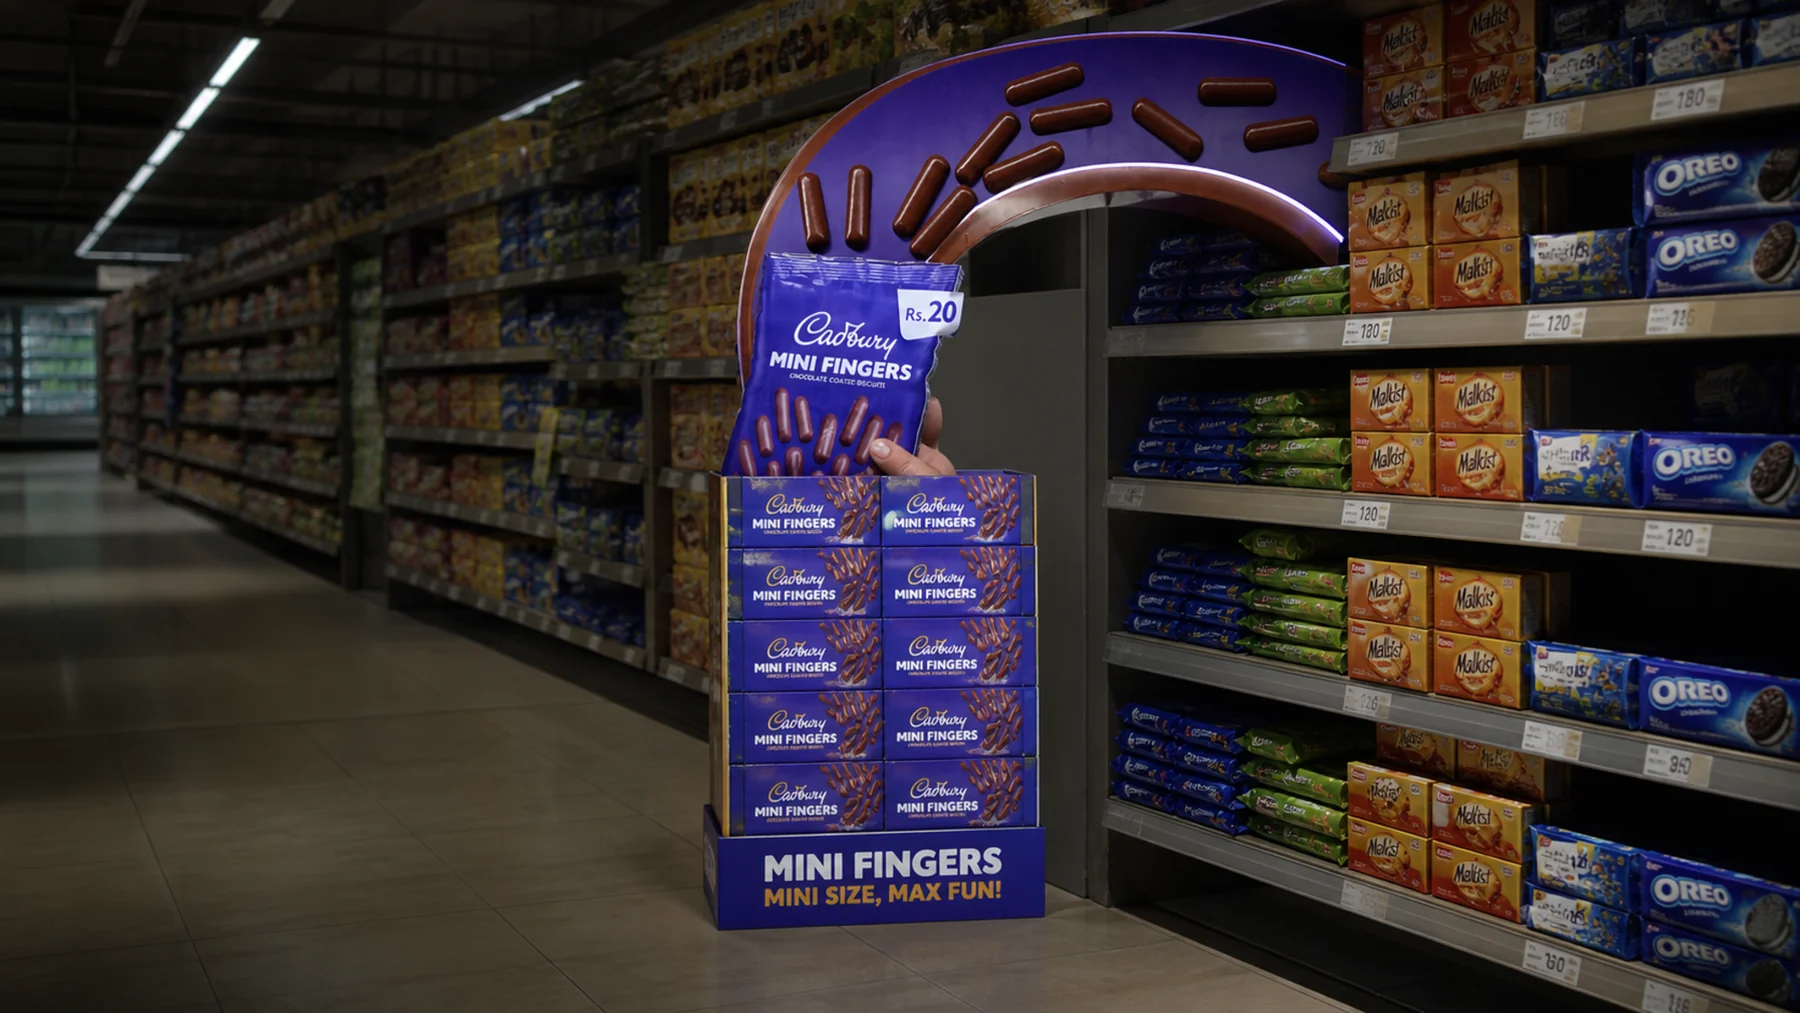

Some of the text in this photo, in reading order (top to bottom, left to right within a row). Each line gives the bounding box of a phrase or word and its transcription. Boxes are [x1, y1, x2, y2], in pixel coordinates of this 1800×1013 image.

[1657, 152, 1739, 191] OREO
[1658, 231, 1737, 266] OREO
[1547, 314, 1571, 332] 120
[793, 311, 899, 360] Cadbury
[769, 351, 913, 381] MINI FINGERS
[1456, 382, 1497, 409] Malkist
[1458, 449, 1497, 474] Malkist
[1654, 445, 1732, 476] OREO
[766, 493, 824, 514] Cadbury
[906, 492, 965, 514] Cadbury
[1359, 506, 1379, 522] 120
[752, 518, 836, 529] MINI FINGERS
[894, 517, 976, 528] MINI FINGERS
[1666, 527, 1694, 547] 120
[766, 565, 826, 587] Cadbury
[907, 563, 966, 586] Cadbury
[753, 589, 836, 601] MINI FINGERS
[894, 588, 977, 600] MINI FINGERS
[767, 637, 827, 659] Cadbury
[908, 635, 967, 657] Cadbury
[754, 662, 837, 673] MINI FINGERS
[896, 659, 978, 671] MINI FINGERS
[1455, 650, 1496, 675] Malkist
[1651, 679, 1729, 706] OREO
[767, 709, 827, 731] Cadbury
[909, 706, 968, 728] Cadbury
[754, 733, 837, 745] MINI FINGERS
[896, 730, 978, 742] MINI FINGERS
[768, 781, 827, 803] Cadbury
[909, 778, 968, 800] Cadbury
[754, 805, 838, 817] MINI FINGERS
[897, 801, 979, 813] MINI FINGERS
[764, 847, 1003, 882] MINI FINGERS
[764, 880, 1002, 907] MINI SIZE, MAX FUN!
[1652, 876, 1731, 907] OREO
[1655, 936, 1730, 965] OREO
